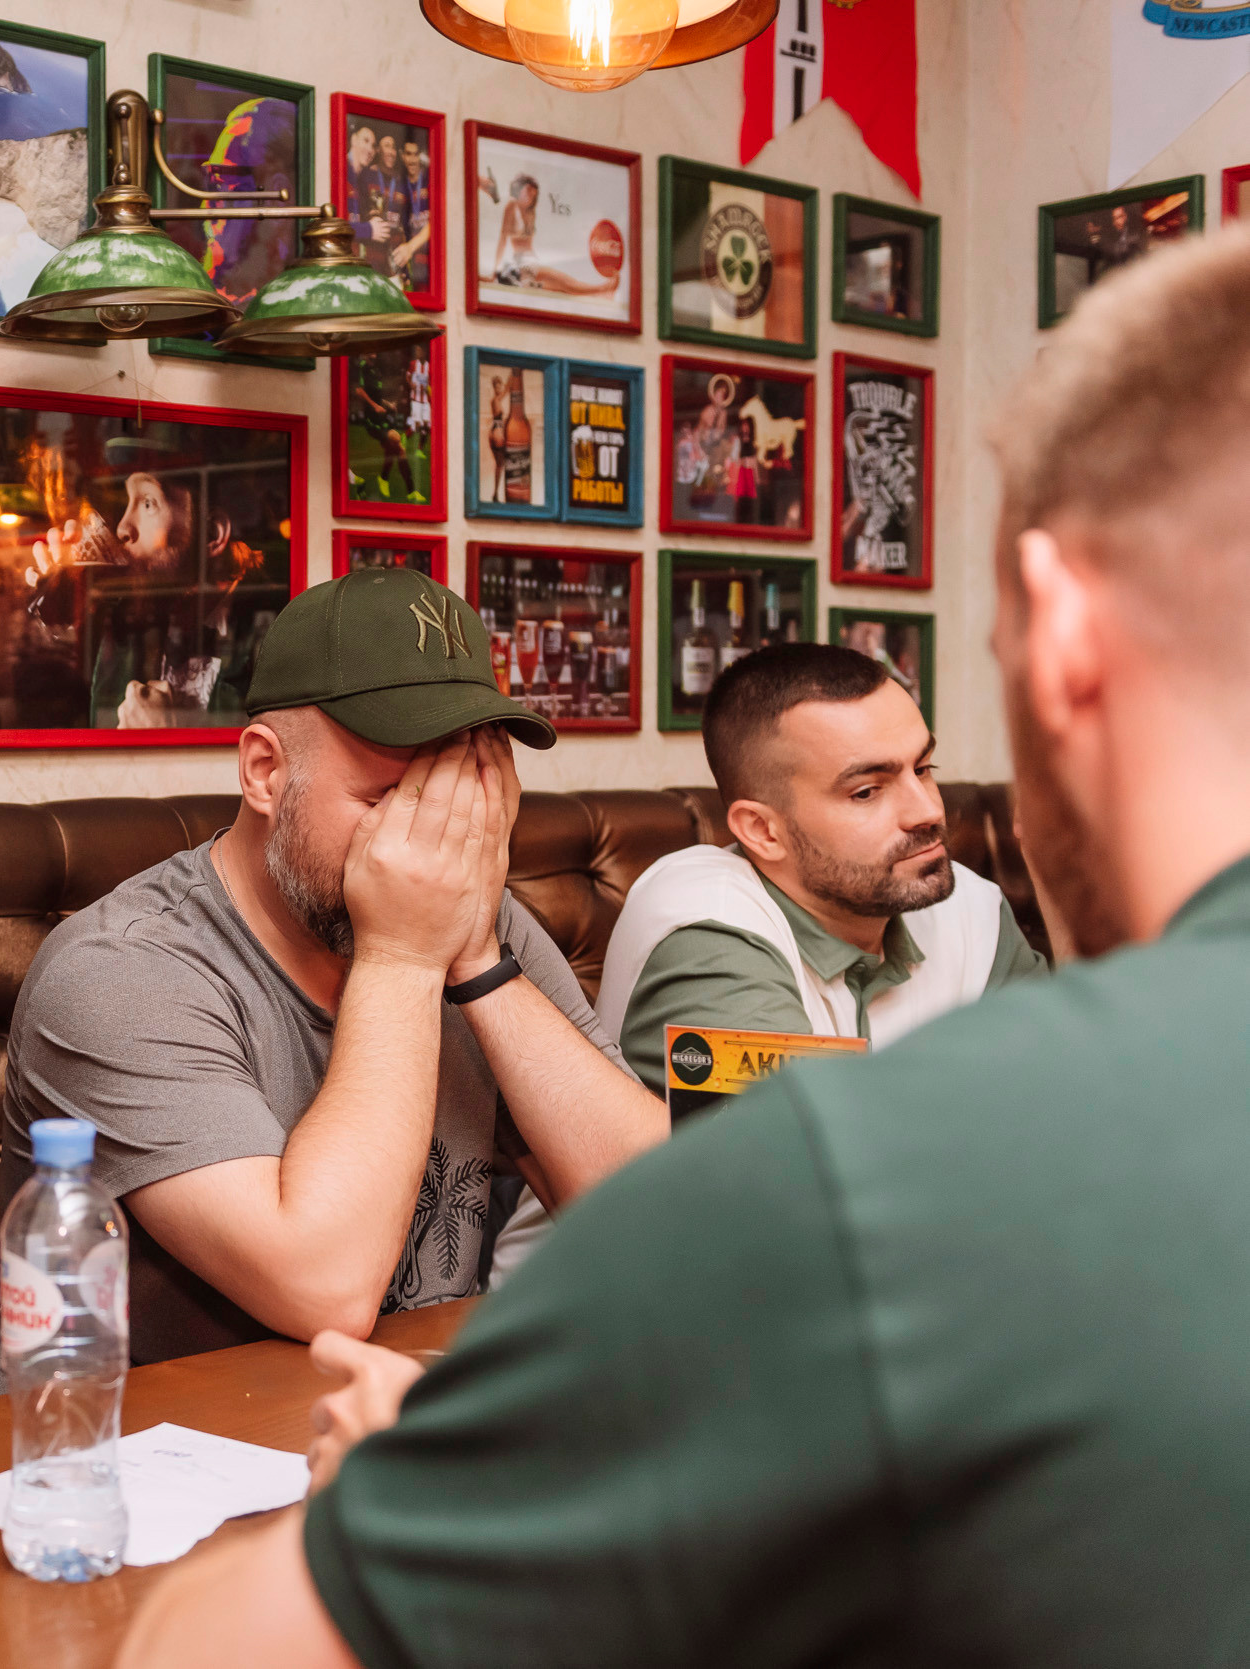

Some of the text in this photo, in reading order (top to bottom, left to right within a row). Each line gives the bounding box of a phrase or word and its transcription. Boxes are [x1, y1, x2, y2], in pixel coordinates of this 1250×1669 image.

[704, 207, 771, 262] SHAMROCK
[598, 445, 620, 478] ОТ
[573, 479, 623, 504] РАБОТЫ
[408, 592, 472, 658] NY
